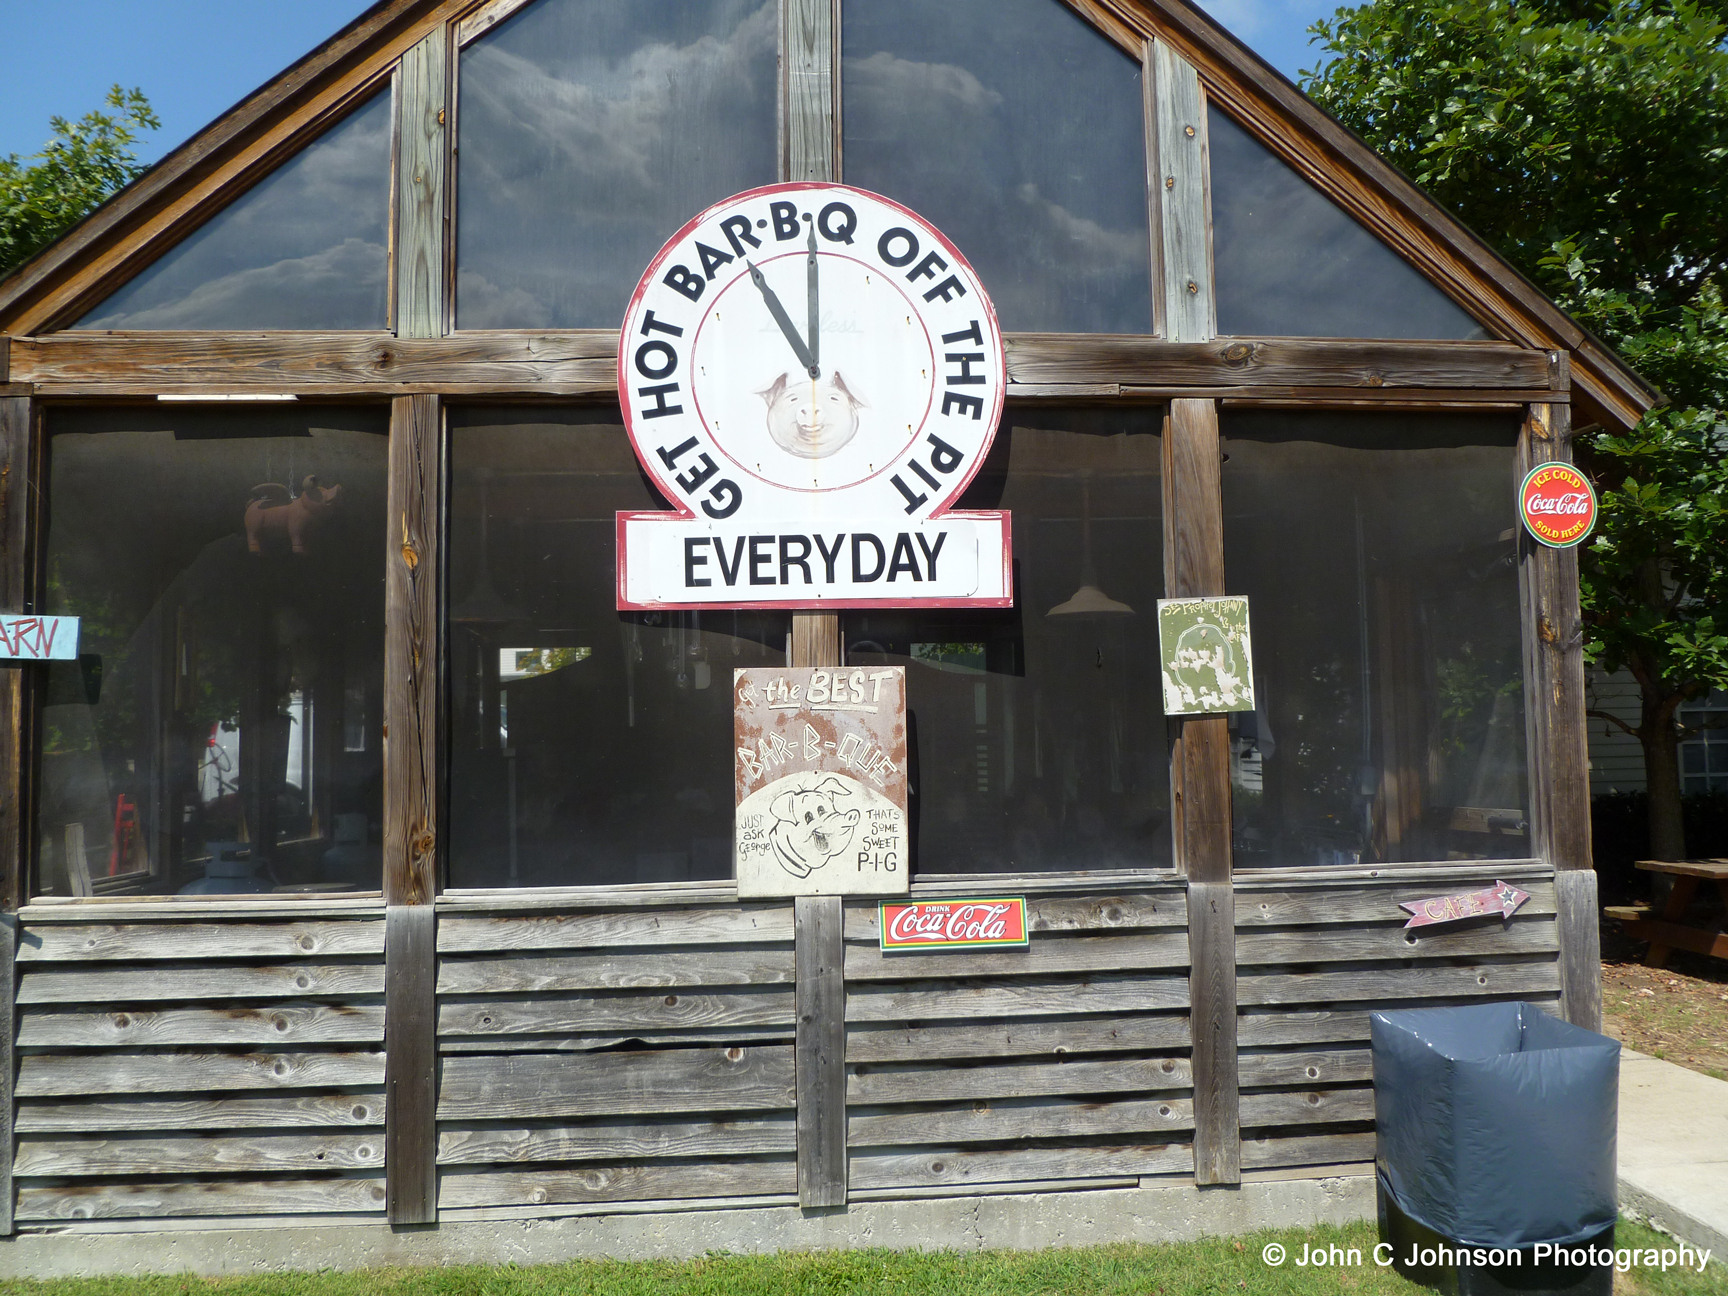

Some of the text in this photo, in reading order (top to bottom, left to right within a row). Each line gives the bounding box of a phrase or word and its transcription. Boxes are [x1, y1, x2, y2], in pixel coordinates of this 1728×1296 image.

[877, 227, 967, 304] OFF
[634, 309, 684, 420] HOT
[941, 320, 987, 421] THE
[656, 436, 743, 519] GET
[889, 433, 965, 516] PIT
[1533, 470, 1581, 488] ICE COLD
[1527, 493, 1589, 515] Coca-Cola
[1535, 520, 1585, 539] SOLD HERE
[684, 532, 948, 588] EVERYDAY
[761, 676, 801, 702] the
[806, 670, 893, 704] BEST
[737, 723, 897, 787] BAR-B-QUE
[741, 814, 764, 830] JUST
[866, 808, 900, 820] THATS
[871, 823, 898, 835] SOME
[863, 836, 899, 851] SWEET
[857, 852, 897, 872] P-I-G
[925, 905, 950, 913] DRINK
[1424, 892, 1483, 920] CAFE
[890, 903, 1012, 941] Coca-Cola
